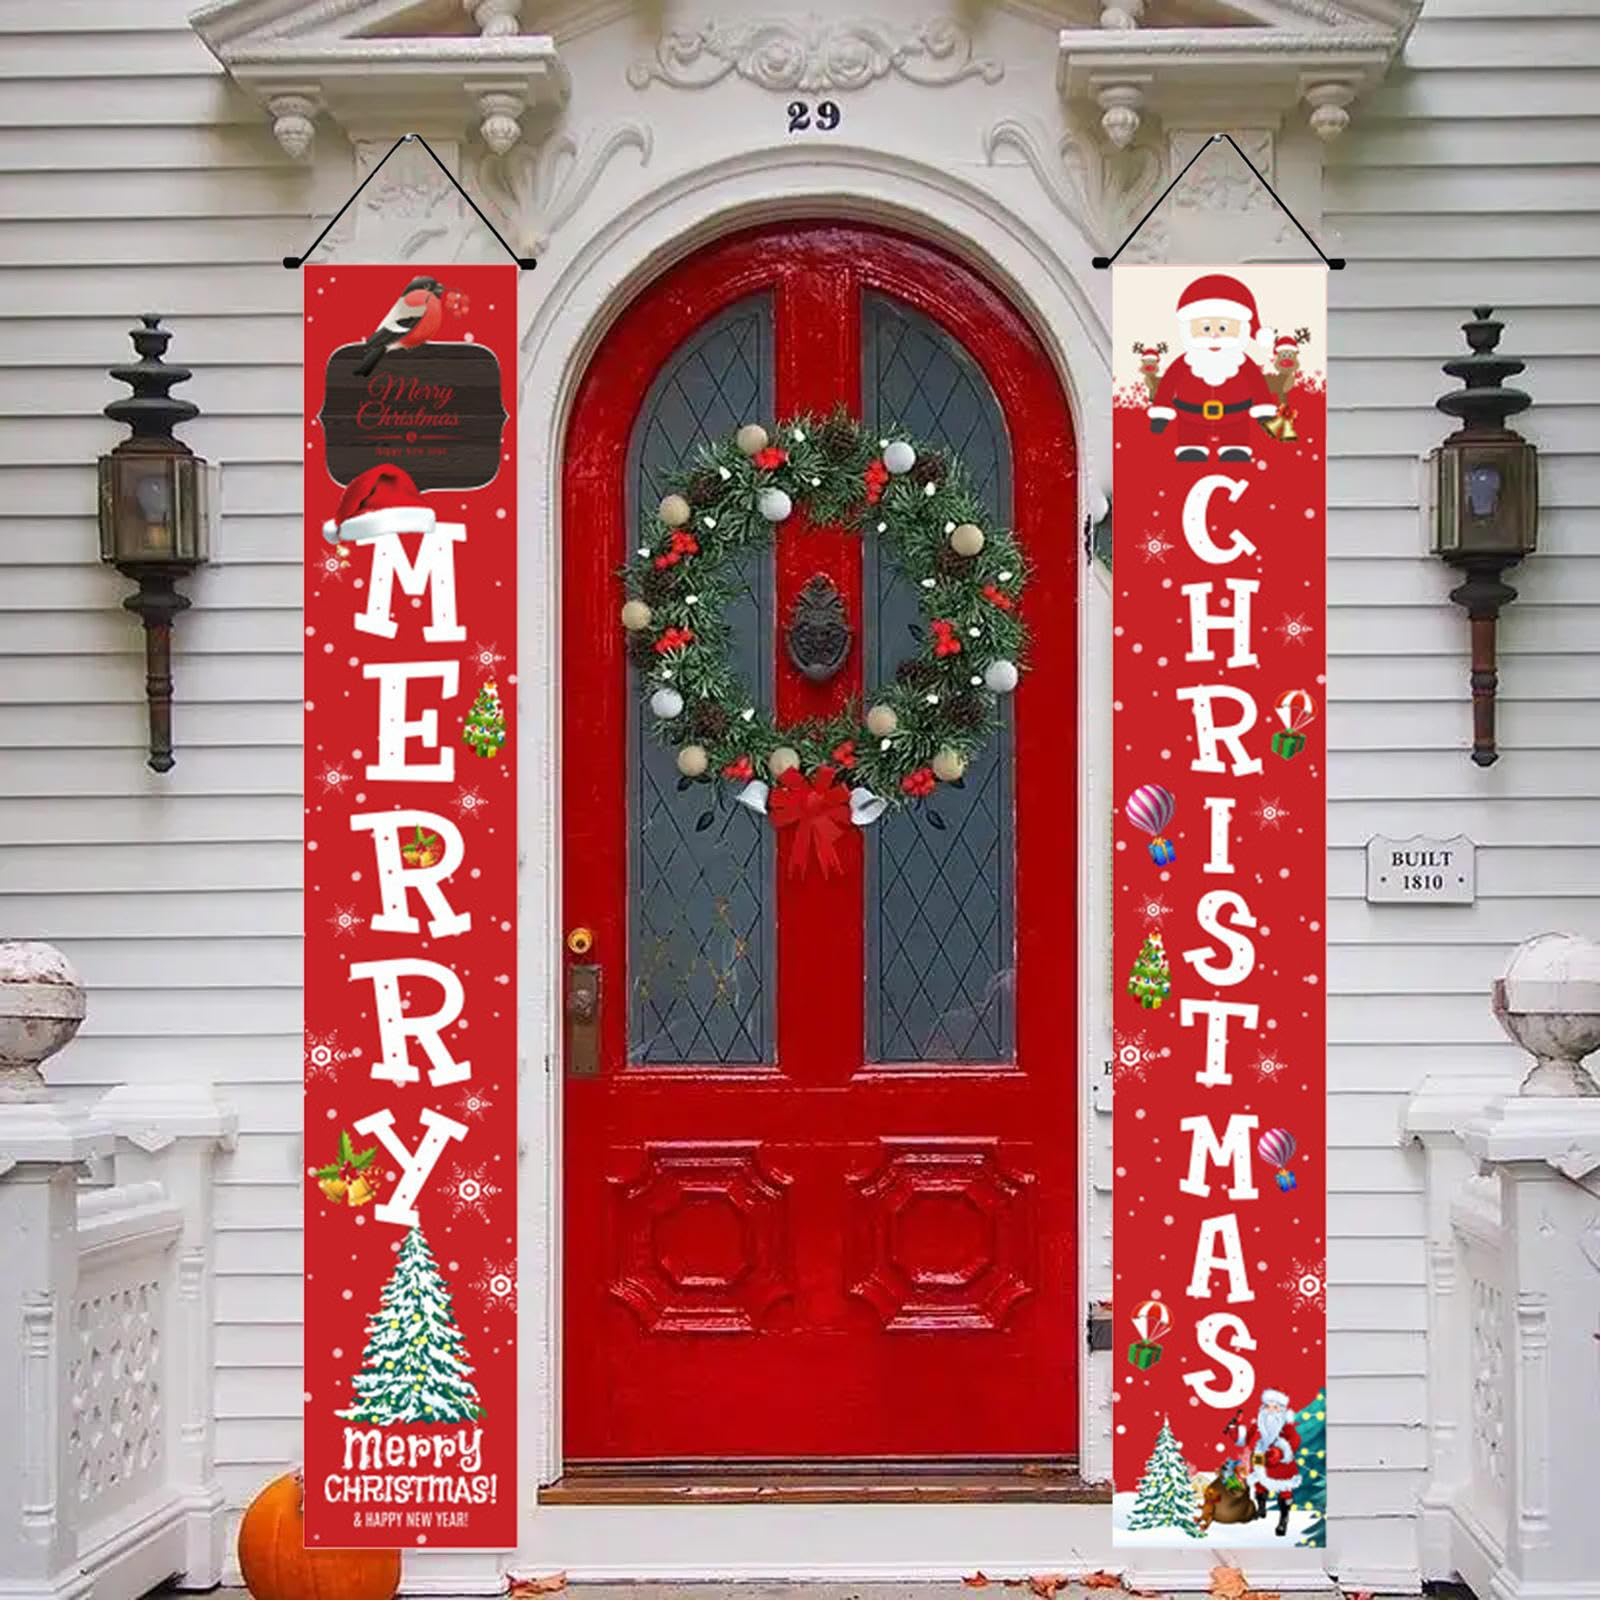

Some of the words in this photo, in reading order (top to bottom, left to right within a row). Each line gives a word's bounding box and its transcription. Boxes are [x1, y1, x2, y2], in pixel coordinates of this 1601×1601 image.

[787, 101, 840, 133] 29
[367, 371, 455, 408] Merry
[355, 398, 460, 430] Christmas
[350, 520, 472, 1227] MERRY
[1391, 851, 1453, 866] BUILT
[1404, 875, 1443, 890] 1810
[1176, 474, 1264, 1409] CHRISTMAS
[324, 1473, 497, 1504] CHRISTMAS!
[353, 1512, 362, 1527] &
[365, 1512, 402, 1527] HAPPY
[406, 1512, 432, 1527] NEW
[436, 1512, 468, 1527] YEAR!
